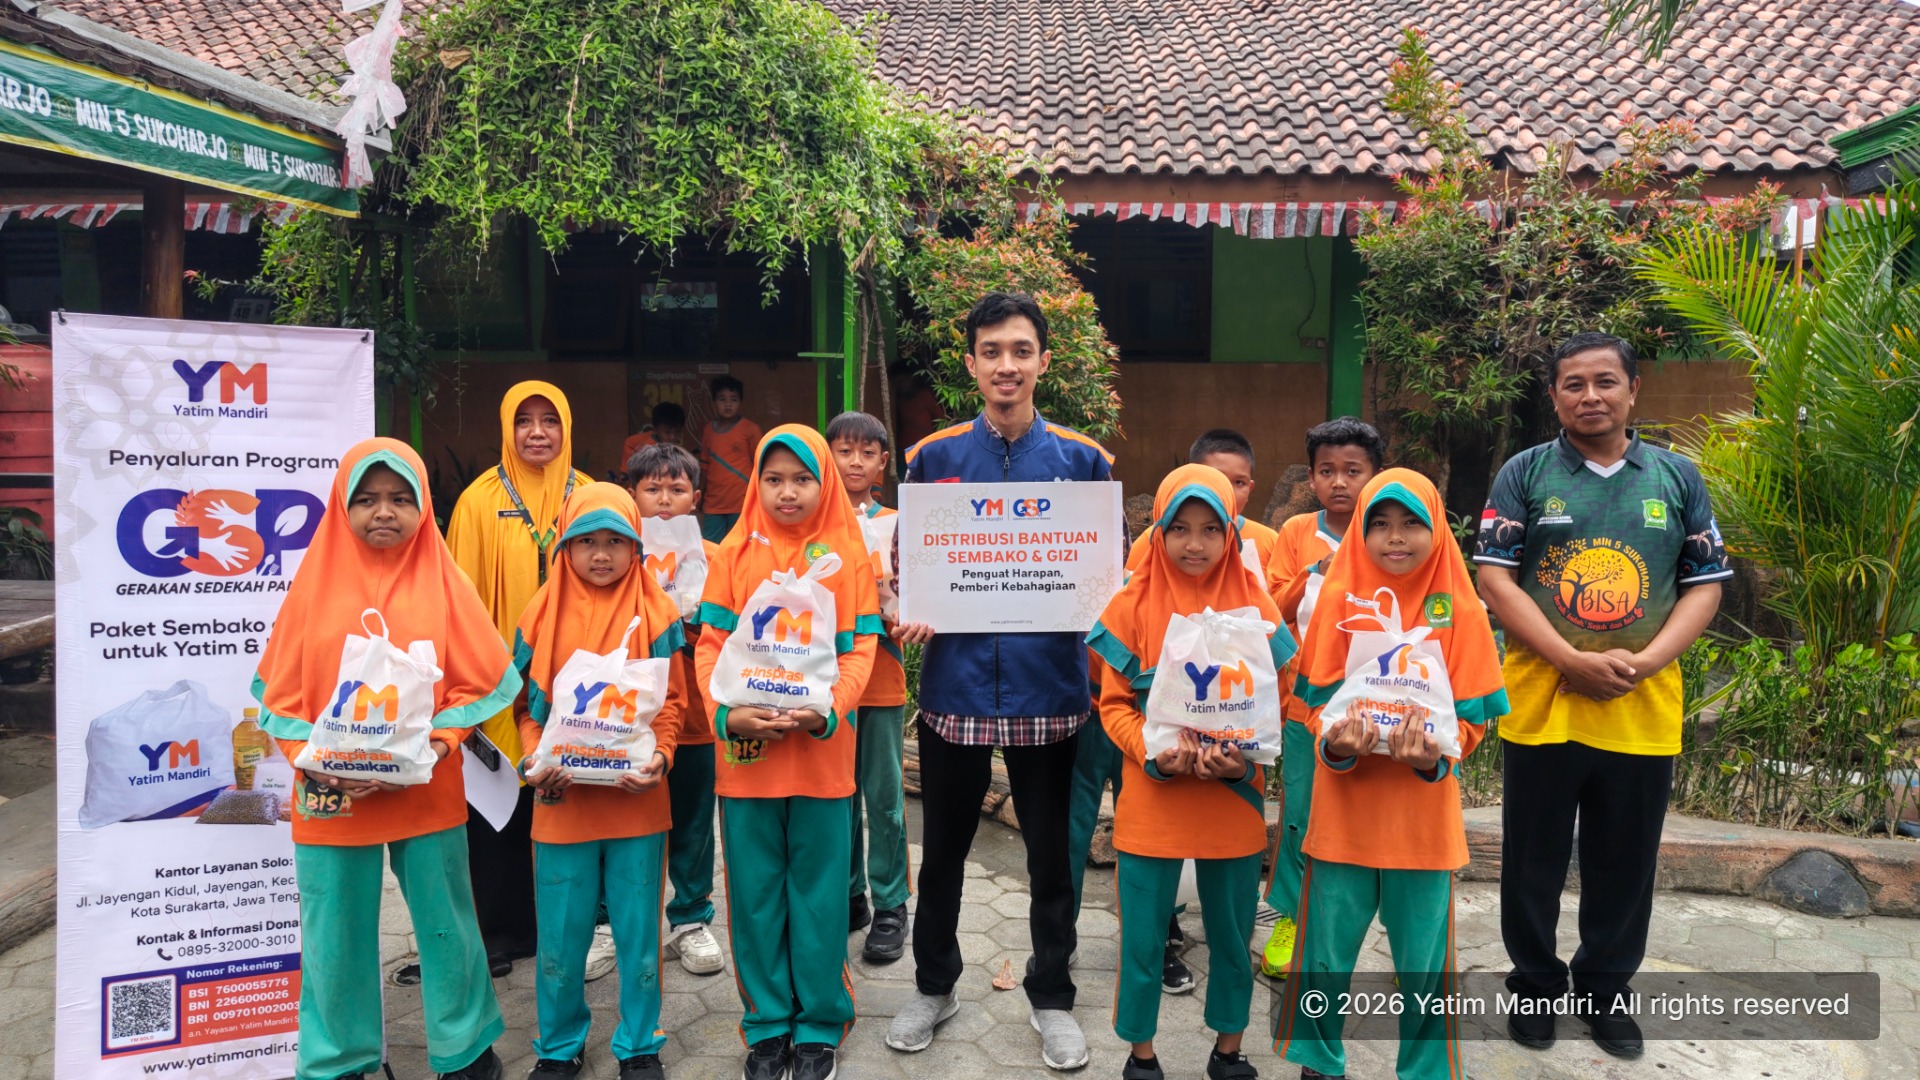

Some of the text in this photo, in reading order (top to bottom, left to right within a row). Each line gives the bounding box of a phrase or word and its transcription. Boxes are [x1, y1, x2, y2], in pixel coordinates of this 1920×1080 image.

[75, 97, 227, 160] MIN 5 SUKOHARJO
[244, 143, 268, 172] MIN
[272, 151, 281, 175] 5
[173, 359, 267, 405] YM
[173, 405, 268, 419] Yatim Mandiri
[109, 449, 339, 474] Penyaluran Program
[971, 498, 1051, 517] YM GSP
[116, 488, 326, 578] GSP
[923, 531, 1098, 547] DISTRIBUSI BANTUAN
[947, 549, 1078, 564] SEMBAKO & GIZI
[962, 568, 1064, 581] Penguat Harapan,
[1593, 537, 1650, 600] MIN 5 SUKOHARJO
[116, 582, 190, 595] GERAKAN
[194, 581, 263, 594] SEDEKAH
[950, 581, 1076, 593] Pemberi Kebahagiaan
[1581, 588, 1630, 614] BISA
[90, 618, 266, 638] Paket Sembako
[752, 605, 813, 645] YM
[103, 639, 259, 659] untuk Yatim &
[746, 642, 810, 656] Yatim Mandiri
[1184, 659, 1254, 701] YM
[1394, 677, 1430, 692] Mandiri
[332, 680, 398, 722] YM
[573, 681, 639, 724] YM
[1184, 701, 1216, 713] Yatim
[323, 718, 397, 735] Yatim Mandiri
[560, 715, 633, 734] Yatim Mandiri
[139, 739, 199, 771] YM
[312, 747, 393, 763] #Inspirasi
[552, 742, 627, 758] #Inspirasi
[321, 760, 400, 773] Kebaikan
[560, 755, 631, 770] Kebaikan
[128, 767, 210, 786] Yatim Mandiri
[306, 792, 352, 811] BISA
[155, 857, 293, 878] Kantor Layanan Solo:
[76, 876, 297, 908] Jl. Jayengan Kidul, Jayengan, Kec.
[131, 906, 161, 918] Kota
[164, 900, 229, 914] Surakarta,
[233, 895, 266, 907] Jawa
[137, 931, 185, 946] Kontak
[188, 930, 197, 940] &
[200, 923, 263, 938] Informasi
[178, 933, 296, 957] 0895-32000-3010
[186, 960, 283, 979] Nomor Rekening:
[189, 977, 289, 998] BSI 7600055776
[189, 990, 289, 1011] BNI 2266000026
[188, 1014, 208, 1024] BRI
[205, 1025, 238, 1037] Yayasan
[240, 1020, 262, 1031] Yatim
[264, 1016, 293, 1027] Mandiri
